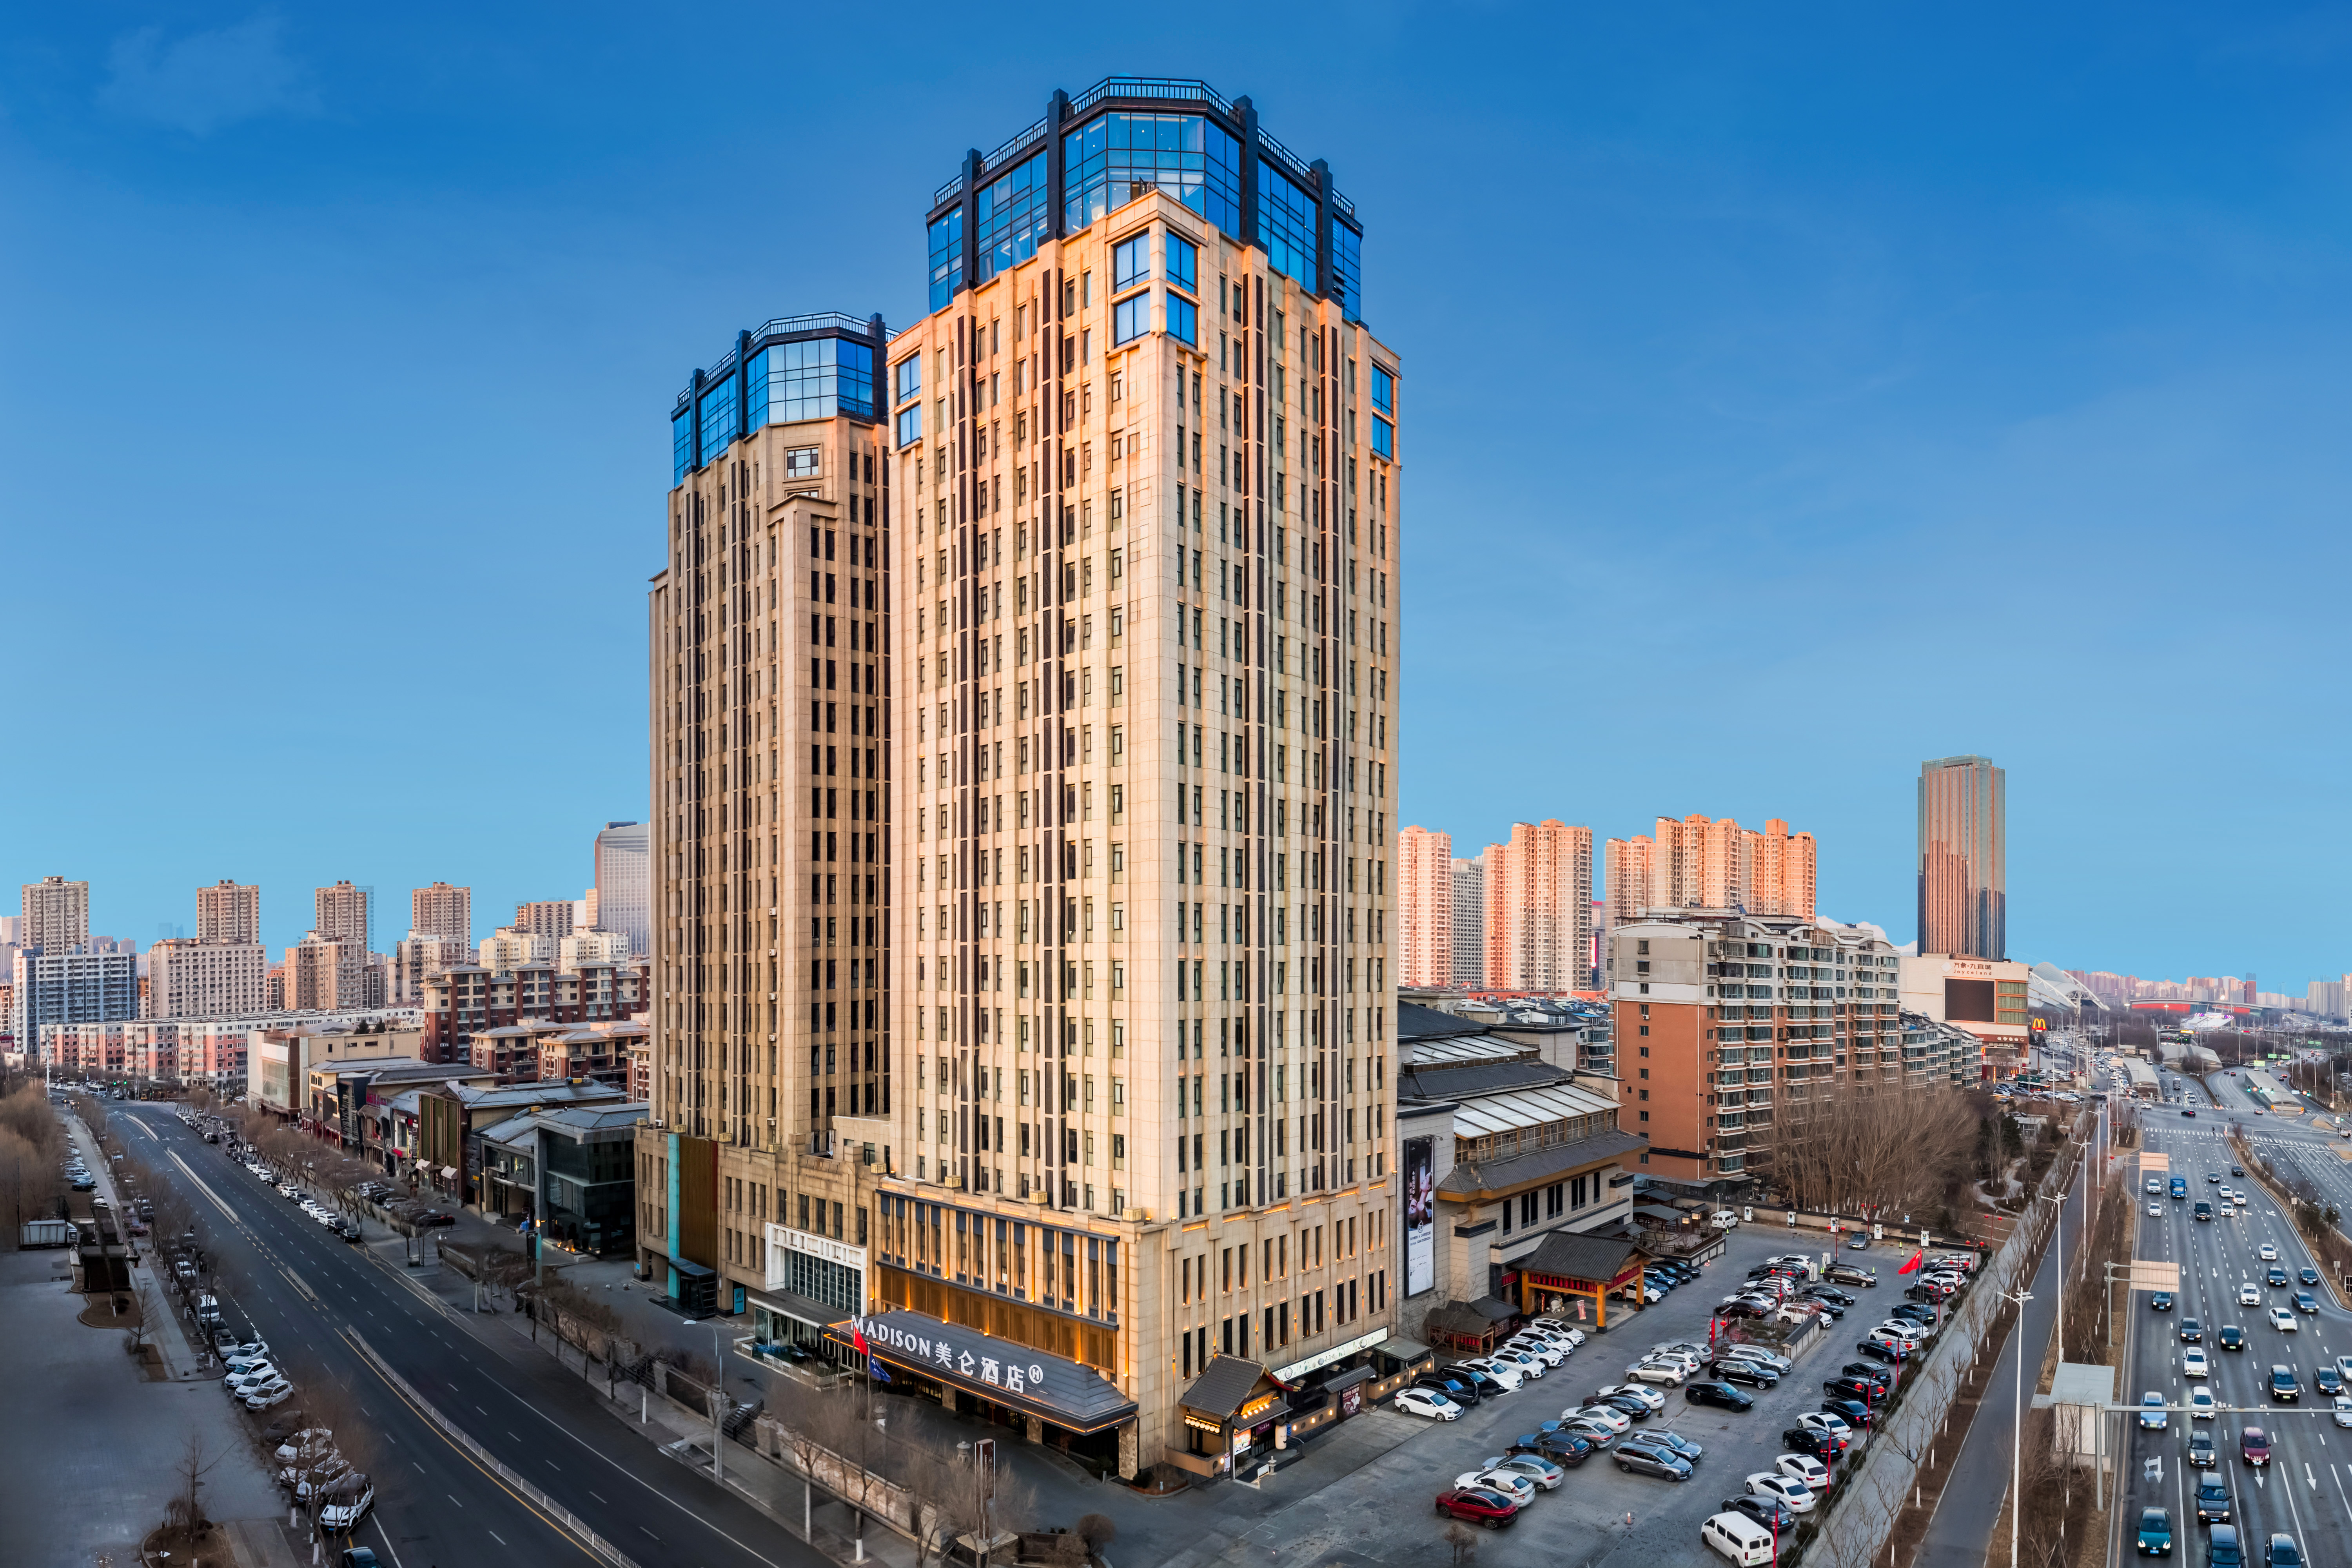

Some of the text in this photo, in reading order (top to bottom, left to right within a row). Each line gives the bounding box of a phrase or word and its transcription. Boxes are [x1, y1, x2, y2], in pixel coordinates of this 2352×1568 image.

[851, 1314, 930, 1358] MADISON
[935, 1341, 1025, 1394] 美仑酒店
